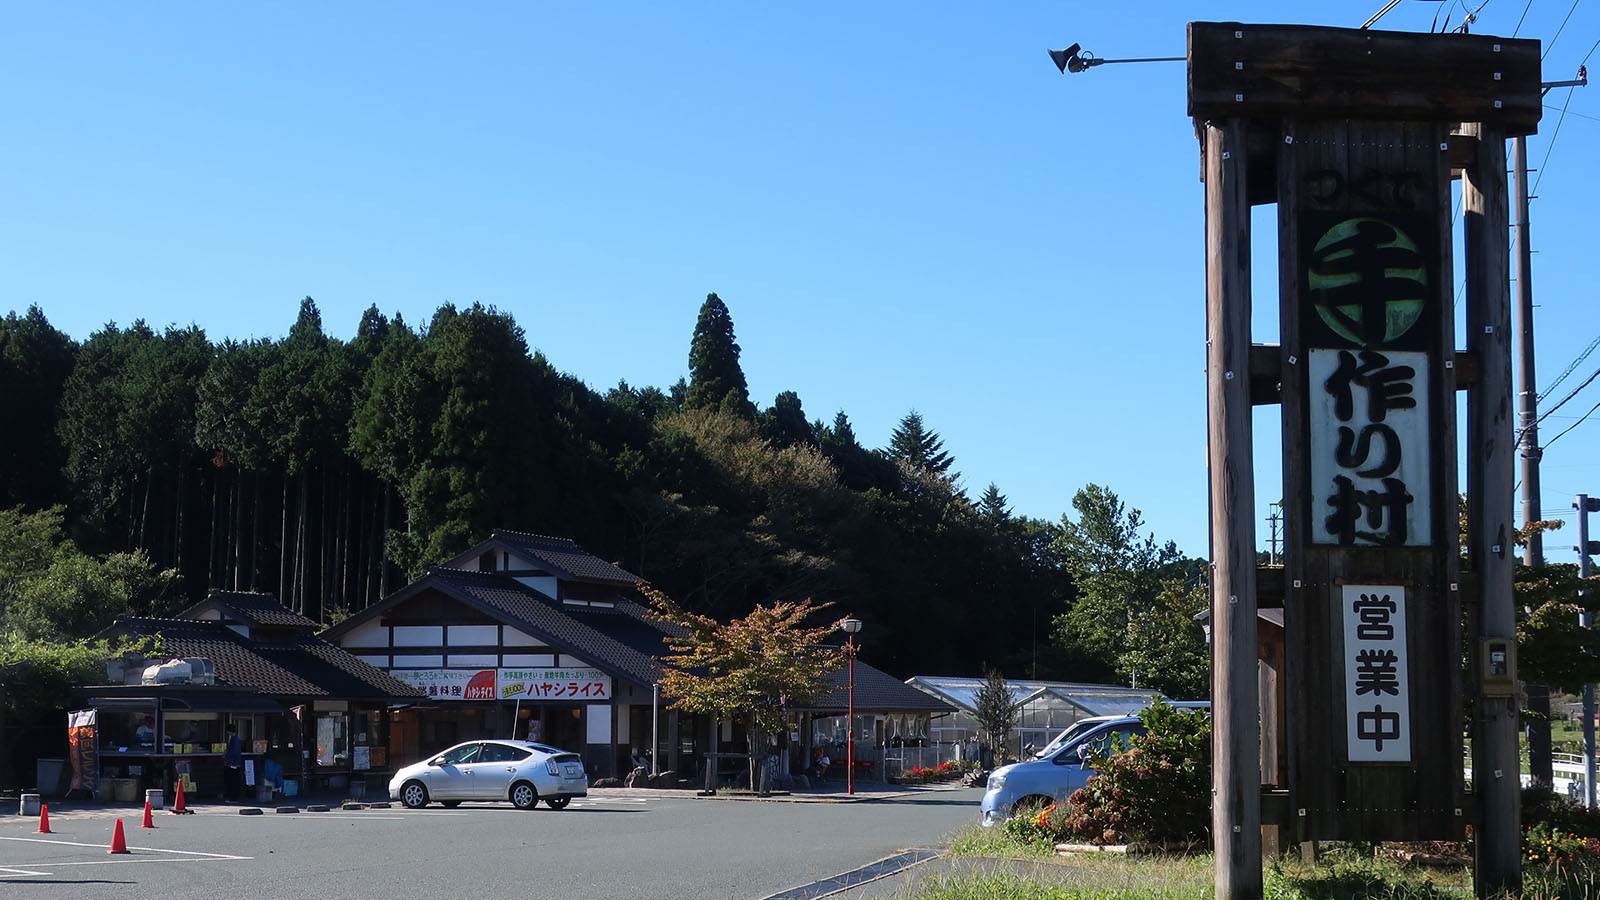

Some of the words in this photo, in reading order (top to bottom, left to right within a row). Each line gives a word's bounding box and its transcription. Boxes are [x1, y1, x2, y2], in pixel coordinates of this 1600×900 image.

[1353, 593, 1400, 752] 営業中
[467, 686, 494, 699] ハヤシライス
[527, 682, 605, 697] ハヤシライス
